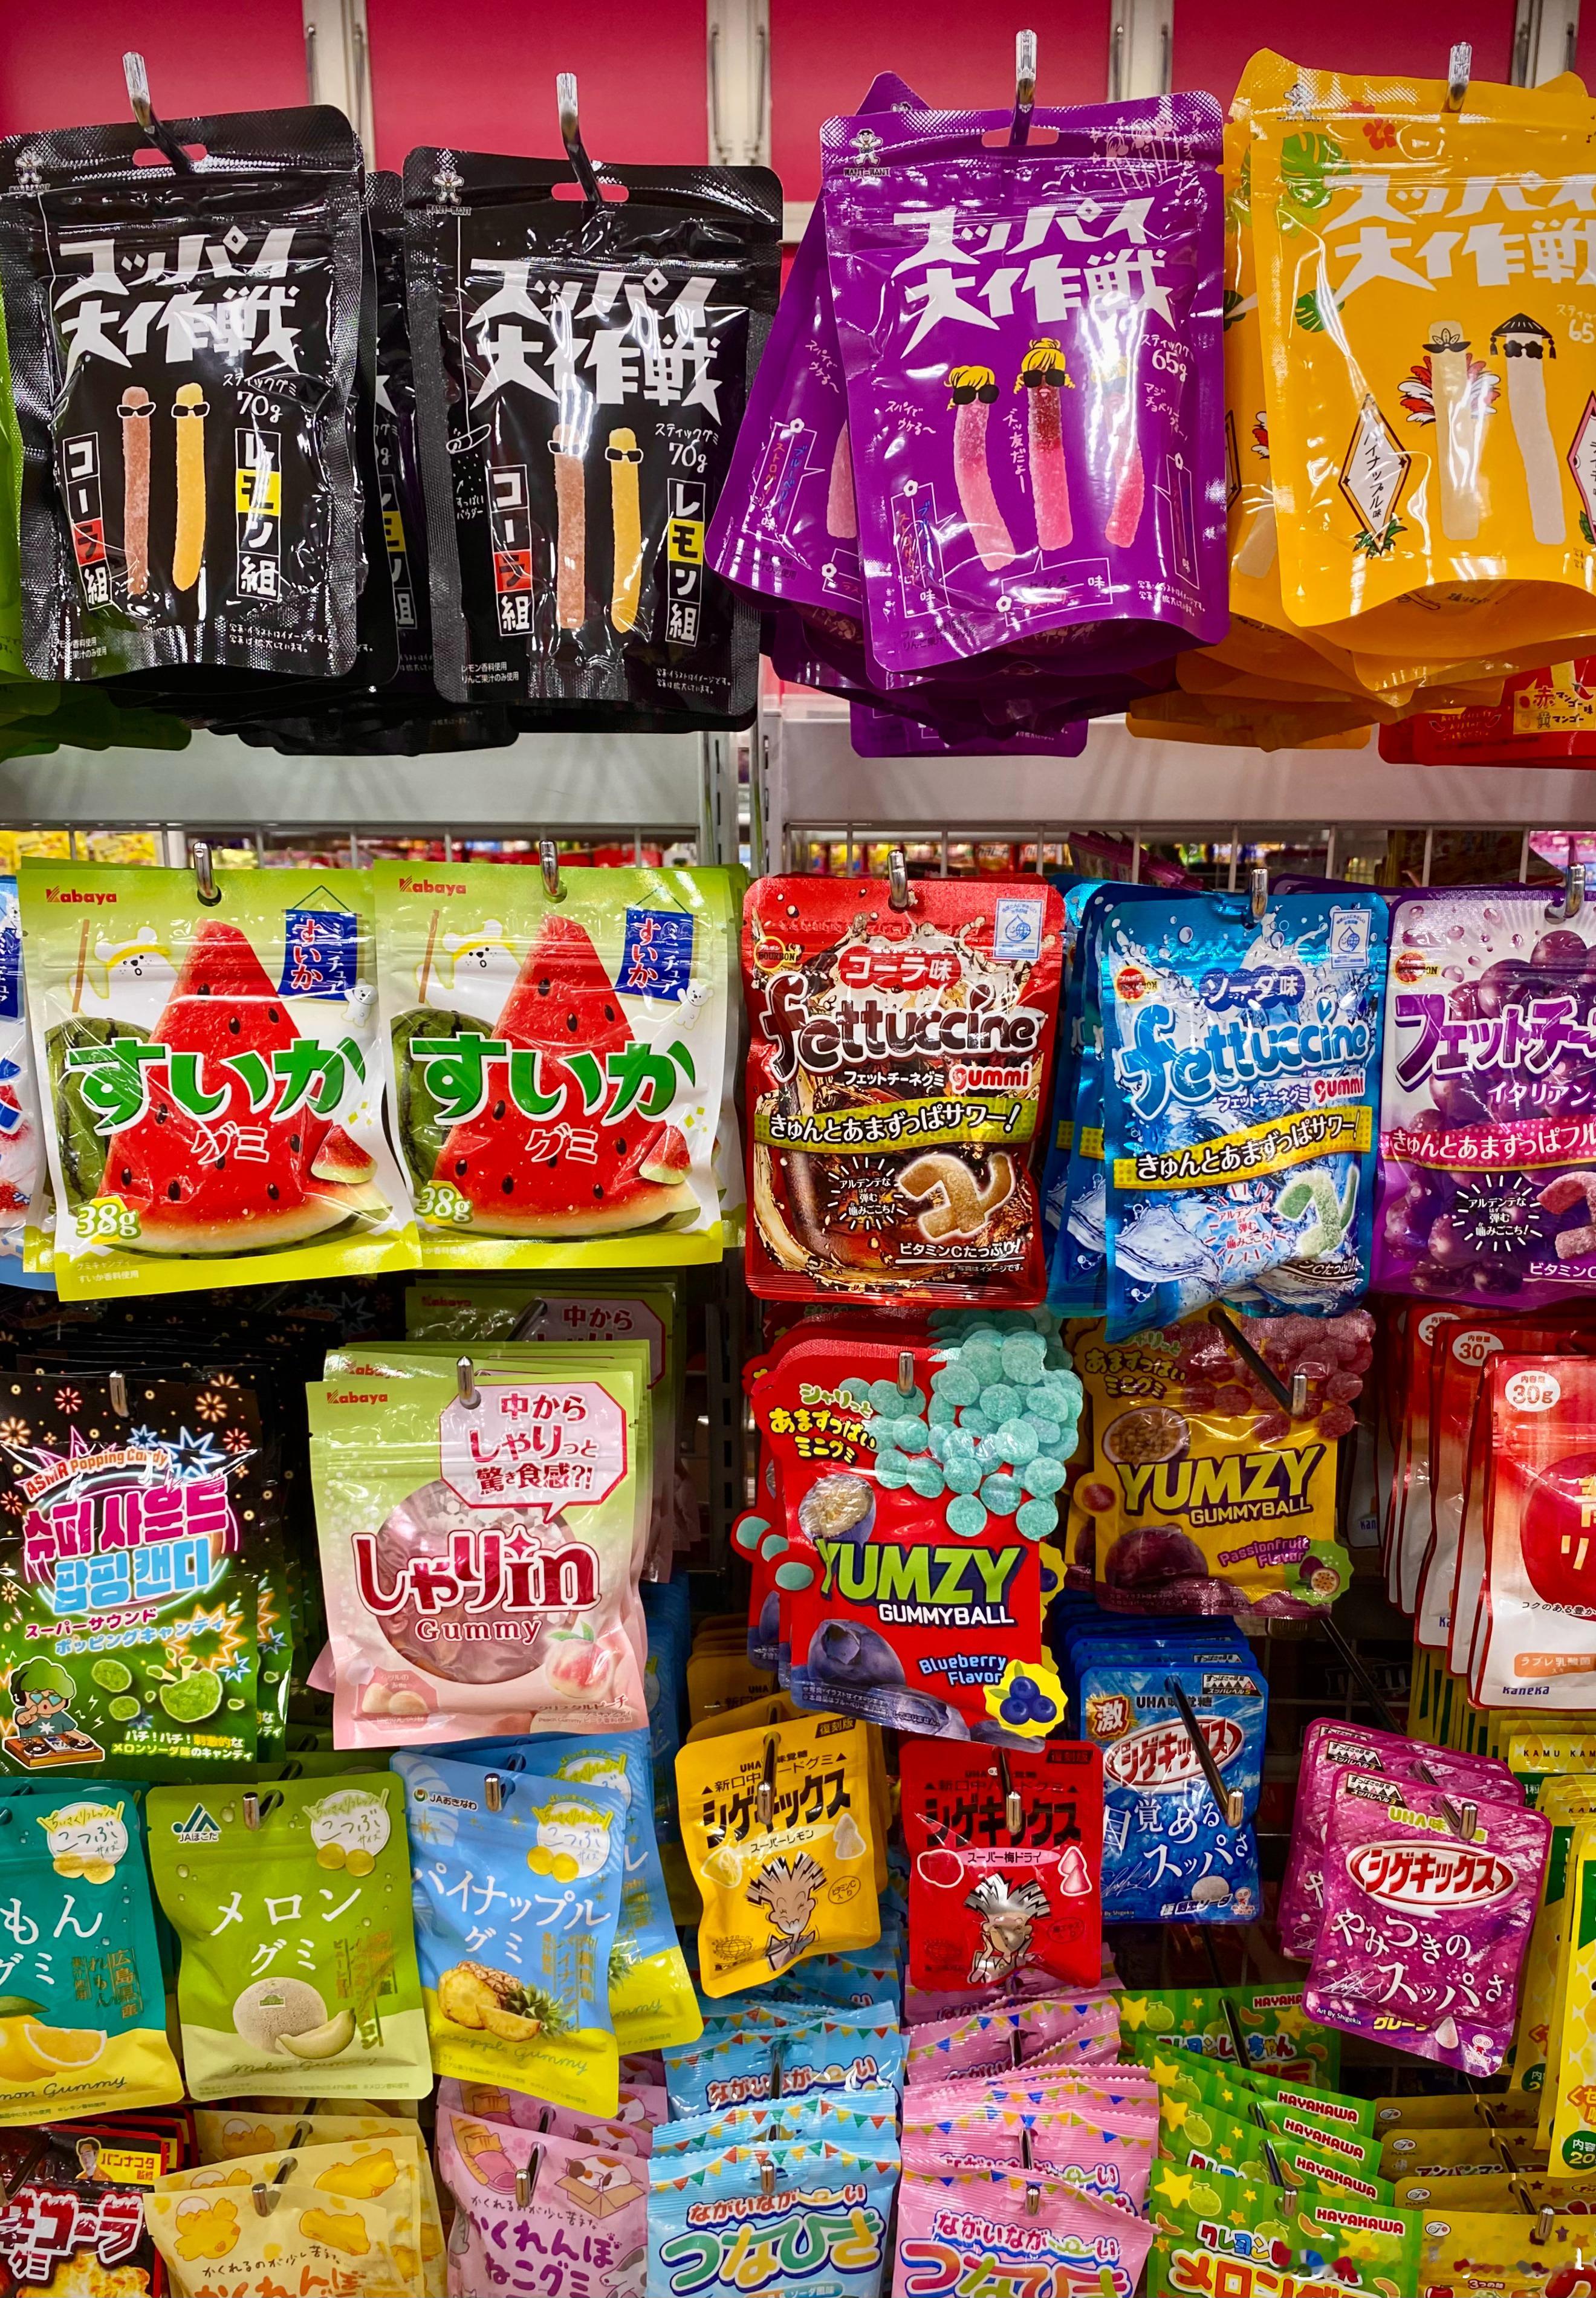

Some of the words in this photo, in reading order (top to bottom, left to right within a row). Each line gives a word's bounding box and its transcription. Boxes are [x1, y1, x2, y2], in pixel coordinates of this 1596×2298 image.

[899, 247, 1176, 359] 大作戦
[57, 285, 302, 387] 大作戦
[470, 323, 724, 426] 大作戦
[1152, 349, 1188, 383] 65g
[236, 390, 284, 424] 70g
[885, 400, 924, 417] スパイで
[667, 442, 709, 475] 70g
[68, 441, 111, 606] コーラ組
[241, 432, 279, 597] レモン組
[492, 471, 531, 632] コーラ組
[669, 482, 703, 644] レモン組
[46, 887, 117, 906] Kabaya
[399, 876, 466, 897] Kabaya
[294, 920, 324, 991] すいか
[628, 917, 661, 989] すいか
[846, 955, 953, 983] コーラ味
[1205, 973, 1299, 1002] ソーダ味
[764, 972, 1041, 1082] fettuccine
[949, 1061, 1033, 1095] gummi
[1117, 1004, 1372, 1120] fettuccine
[65, 1036, 367, 1135] すいか
[410, 1032, 696, 1126] すいか
[843, 1070, 945, 1088] フェットチーネグミ
[1313, 1077, 1364, 1106] gummi
[1218, 1086, 1309, 1113] フェットチーネグミ
[191, 1121, 270, 1166] グミ
[525, 1122, 598, 1165] グミ
[839, 1177, 891, 1190] アルデンテな
[417, 1185, 474, 1224] 38g
[1217, 1201, 1270, 1222] アルデンテな
[1468, 1195, 1527, 1209] アルデンテな
[76, 1202, 141, 1240] 38g
[563, 1305, 634, 1331] 中から
[1085, 1348, 1186, 1381] あまずっぱい
[327, 1390, 388, 1406] Kabaya
[501, 1393, 588, 1422] 中から
[799, 1384, 874, 1417] シャリっと
[1513, 1384, 1554, 1404] 30g
[469, 1424, 598, 1463] しゃりっと
[769, 1407, 878, 1450] あまずっぱい
[794, 1435, 856, 1463] ミニグミ
[26, 1461, 70, 1499] ASMR
[70, 1450, 125, 1473] Popping
[1116, 1444, 1326, 1513] YUMZY
[24, 1500, 94, 1562] 슈퍼
[100, 1475, 230, 1551] 사운드
[1190, 1496, 1312, 1527] GUMMYBALL
[1218, 1536, 1311, 1568] Passionfruit
[1257, 1550, 1306, 1568] Flavor
[54, 1551, 131, 1615] 팝핑
[132, 1537, 211, 1599] 캔디
[814, 1537, 1023, 1604] YUMZY
[24, 1608, 158, 1640] スーパーサウンド
[415, 1617, 542, 1645] Gummy
[878, 1603, 1016, 1626] GUMMYBALL
[55, 1617, 225, 1655] ポッピングキャンディ
[919, 1654, 1008, 1675] Blueberry
[947, 1670, 1004, 1686] Flavor
[1137, 1696, 1166, 1709] UHA
[1502, 1684, 1550, 1696] Kaneka
[1096, 1700, 1123, 1734] 激
[112, 1743, 254, 1761] メロンソーダ味のキャンディ
[740, 1760, 762, 1773] UHA
[1523, 1750, 1561, 1758] KAMU
[429, 1794, 478, 1811] JAおきなわ
[1390, 1806, 1427, 1828] UHA
[178, 1832, 218, 1842] JAほこた
[750, 1829, 814, 1854] スーパーレモン
[967, 1851, 1042, 1863] スーパー梅ドライ
[1143, 1832, 1248, 1889] スッパさ
[1365, 1849, 1496, 1894] シゲキックス
[211, 1887, 362, 1936] メロン
[414, 1862, 612, 1932] パイナップル
[464, 1926, 524, 1965] グミ
[1331, 1907, 1471, 1965] やみつきの
[250, 1938, 316, 1977] グミ
[1376, 1961, 1506, 2012] スッパさ
[1316, 2007, 1327, 2017] Art
[1327, 2011, 1336, 2021] By
[1337, 2013, 1362, 2026] Shigekix
[514, 2046, 588, 2076] Gummy
[43, 2075, 128, 2096] Gummy
[1278, 2091, 1358, 2122] HAYAKAWA
[1285, 2118, 1364, 2160] HAYAKAWA
[1296, 2155, 1378, 2198] HAYAKAWA
[1316, 2208, 1404, 2235] HAYAKAWA
[664, 2207, 883, 2289] つなひき
